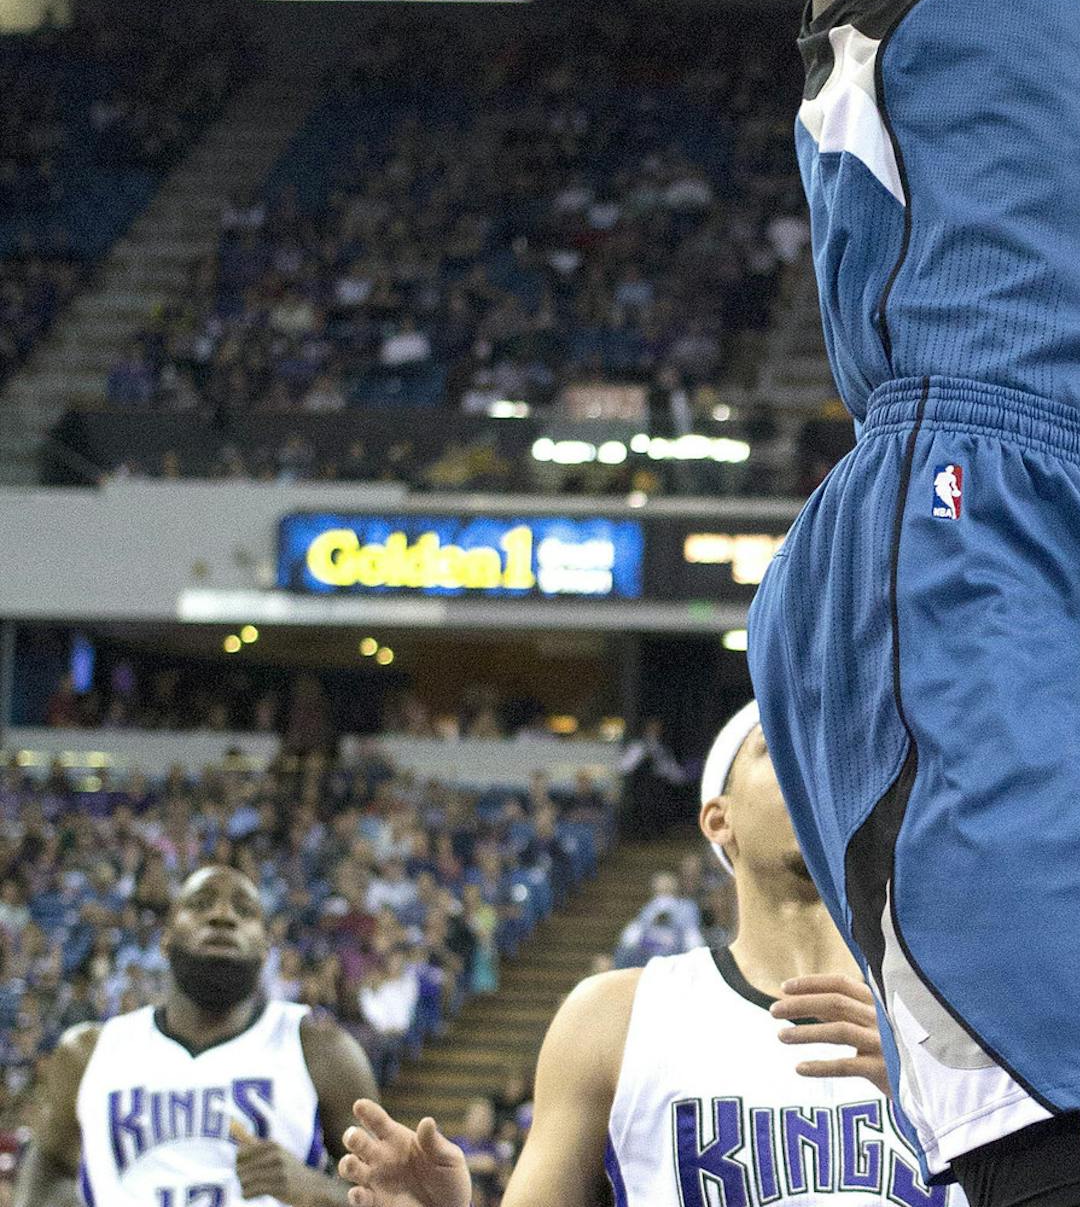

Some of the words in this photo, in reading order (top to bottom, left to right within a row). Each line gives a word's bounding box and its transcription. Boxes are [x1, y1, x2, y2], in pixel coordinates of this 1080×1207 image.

[932, 507, 952, 518] NBA
[500, 525, 535, 589] 1
[108, 1078, 273, 1176] KINGS
